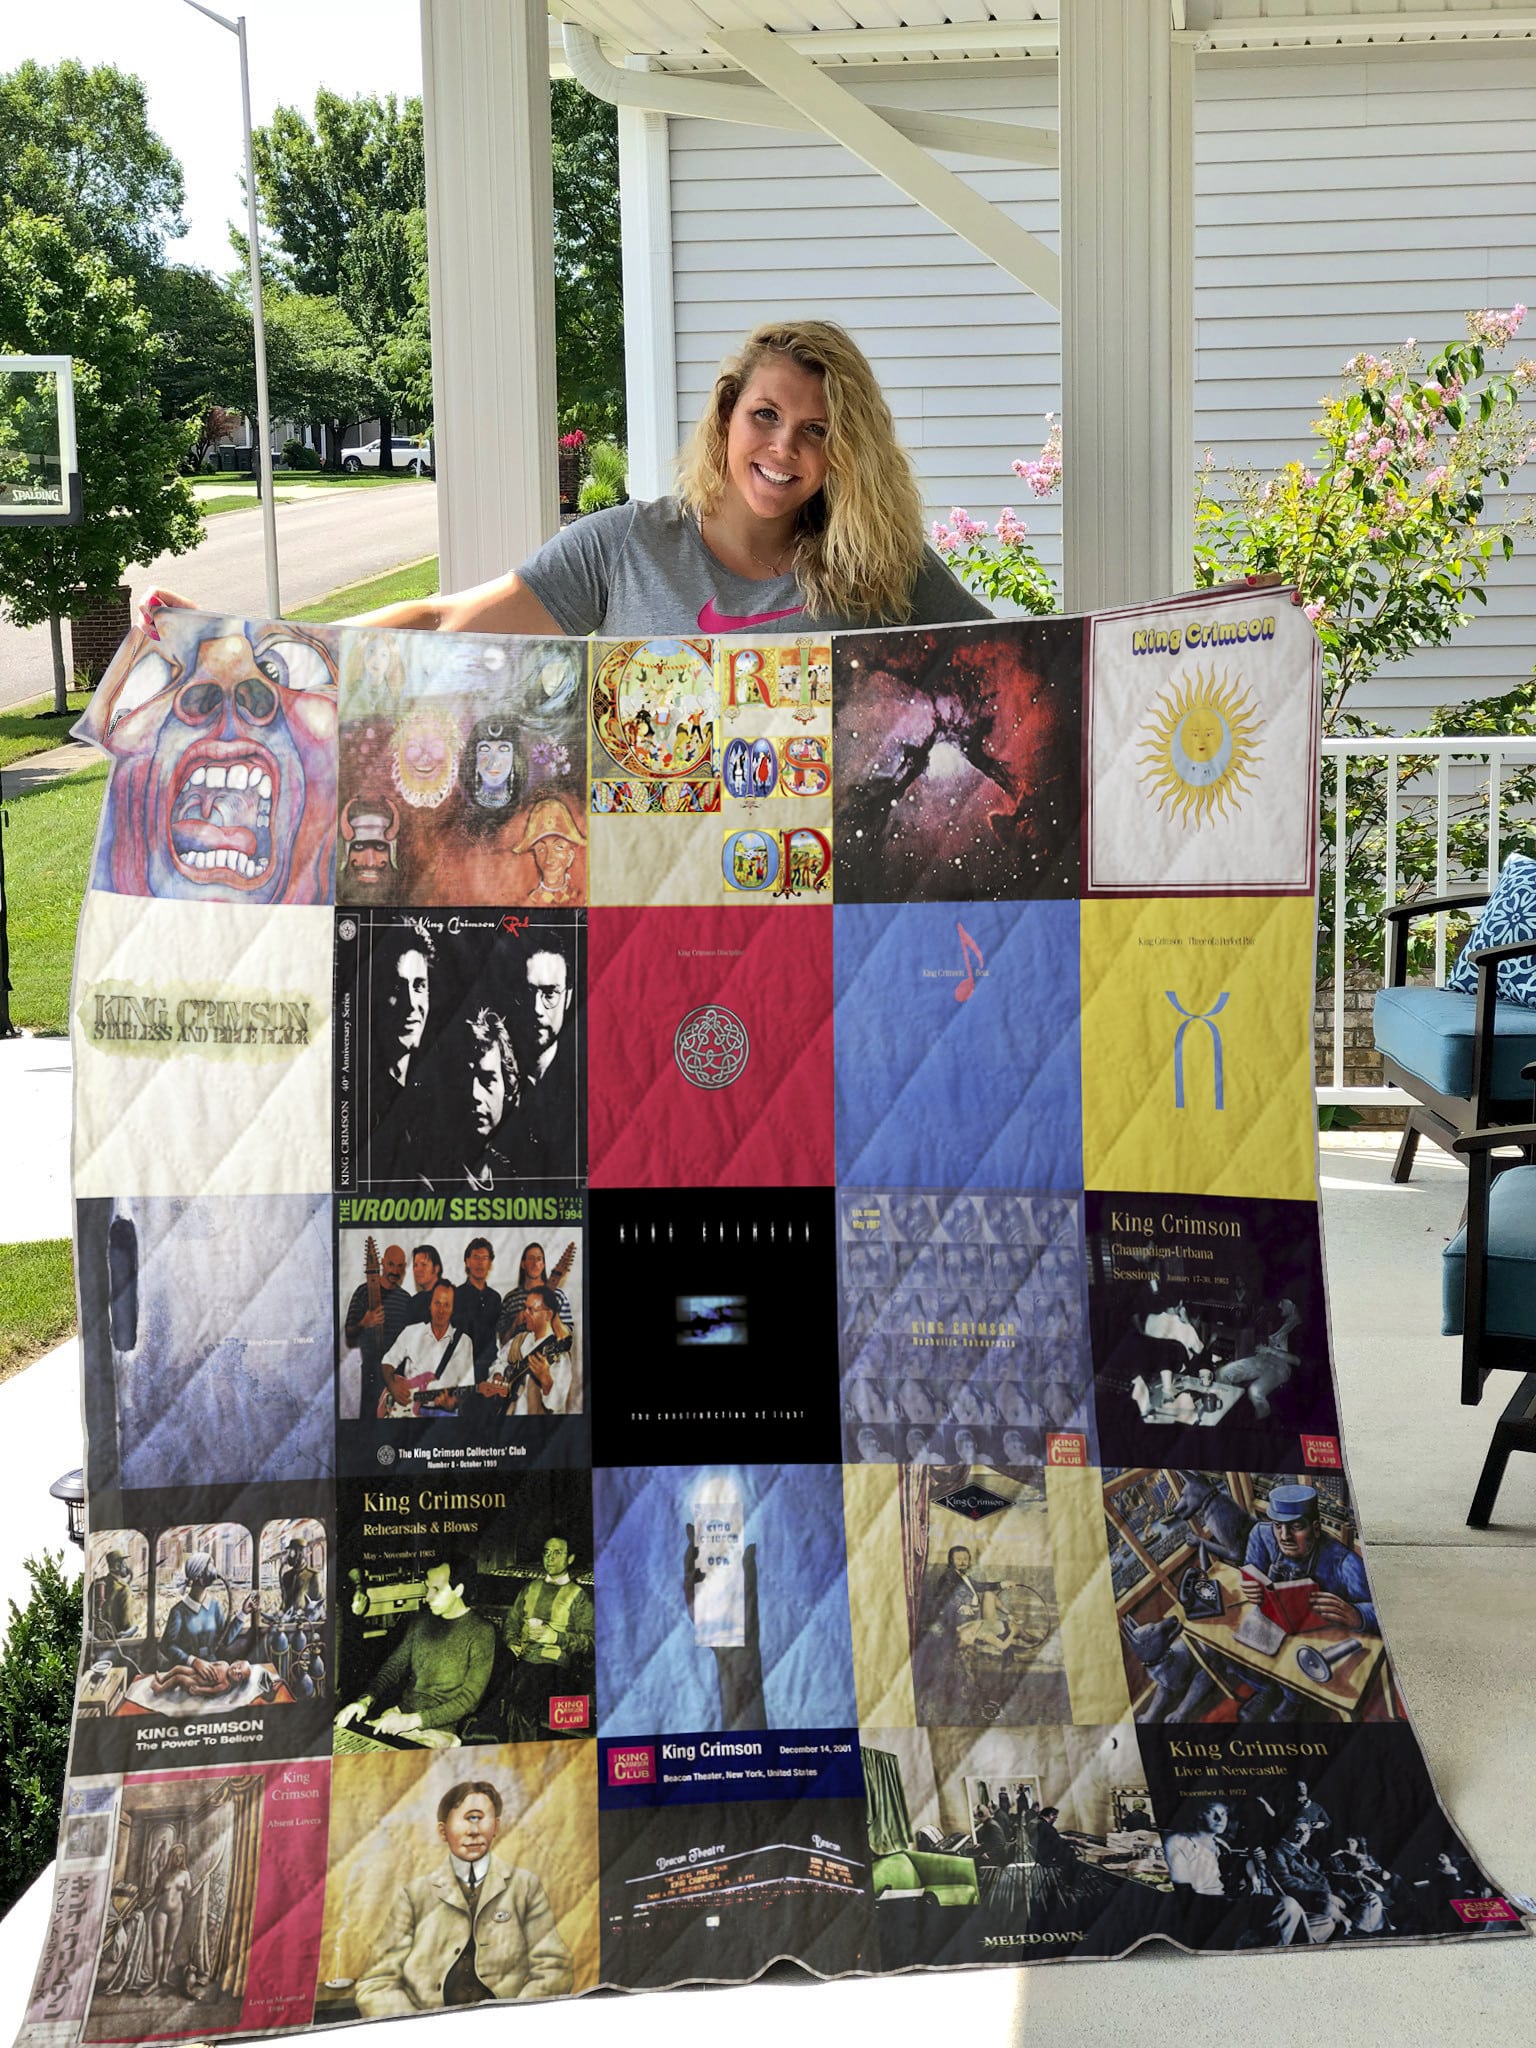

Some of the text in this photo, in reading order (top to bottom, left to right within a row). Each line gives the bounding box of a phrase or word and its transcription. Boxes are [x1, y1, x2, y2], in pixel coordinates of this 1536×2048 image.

[12, 489, 61, 502] SPALDING
[1132, 616, 1276, 655] King Crimson
[94, 994, 311, 1032] KING CRIMSON
[341, 992, 350, 1018] Series
[341, 1018, 352, 1073] Anniversary
[341, 1100, 350, 1155] CRIMSON
[341, 1158, 350, 1186] KING
[340, 1200, 350, 1223] THE
[351, 1197, 558, 1221] VROOOM SESSIONS
[559, 1209, 583, 1220] 1994
[1111, 1211, 1242, 1238] King Crimson
[1111, 1243, 1214, 1260] Champaign-Urbana
[1112, 1267, 1160, 1281] Sessions
[912, 1321, 1016, 1337] KING CRIMSON
[398, 1449, 413, 1459] The
[413, 1449, 431, 1460] King
[432, 1447, 465, 1458] Crimson
[508, 1446, 527, 1456] Club
[363, 1490, 507, 1516] King Crimson
[363, 1520, 479, 1537] Rehearsals & Blows
[136, 1719, 264, 1741] KING CRIMSON
[135, 1733, 264, 1752] The Power To Believe
[662, 1744, 696, 1762] King
[699, 1742, 763, 1758] Crimson
[779, 1745, 818, 1755] December
[1168, 1739, 1329, 1760] King Crimson
[617, 1752, 649, 1762] KING
[282, 1771, 310, 1785] King
[725, 1770, 744, 1780] New
[1174, 1764, 1288, 1777] Live in Newcastle
[271, 1788, 320, 1801] Crimson
[983, 1930, 1085, 1947] MELTDOWN
